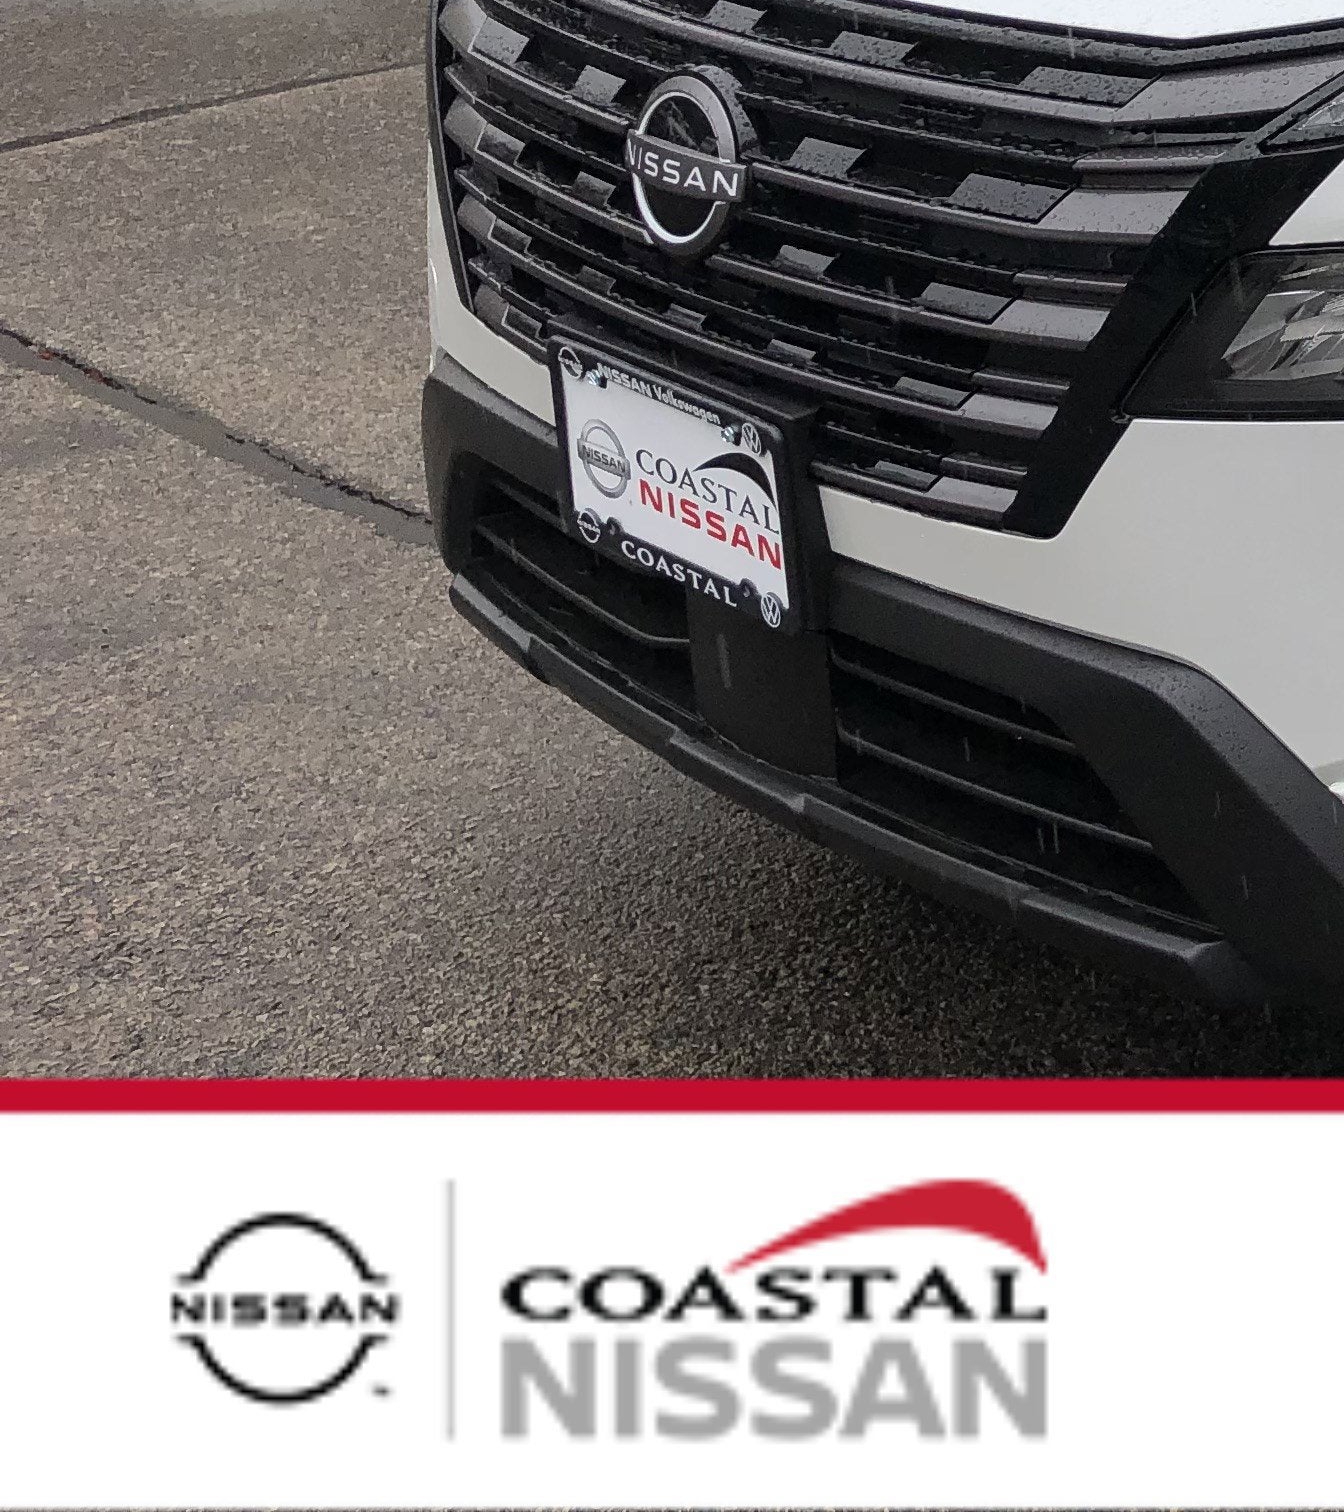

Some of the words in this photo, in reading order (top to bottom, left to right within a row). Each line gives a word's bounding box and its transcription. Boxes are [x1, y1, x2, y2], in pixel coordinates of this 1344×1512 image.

[627, 133, 739, 198] NISSAN
[596, 362, 653, 398] NISSAN
[653, 383, 722, 425] Volkswagen
[582, 443, 627, 472] NISSAN
[635, 449, 780, 535] COASTAL
[639, 478, 782, 570] NISSAN
[621, 539, 738, 608] COASTAL
